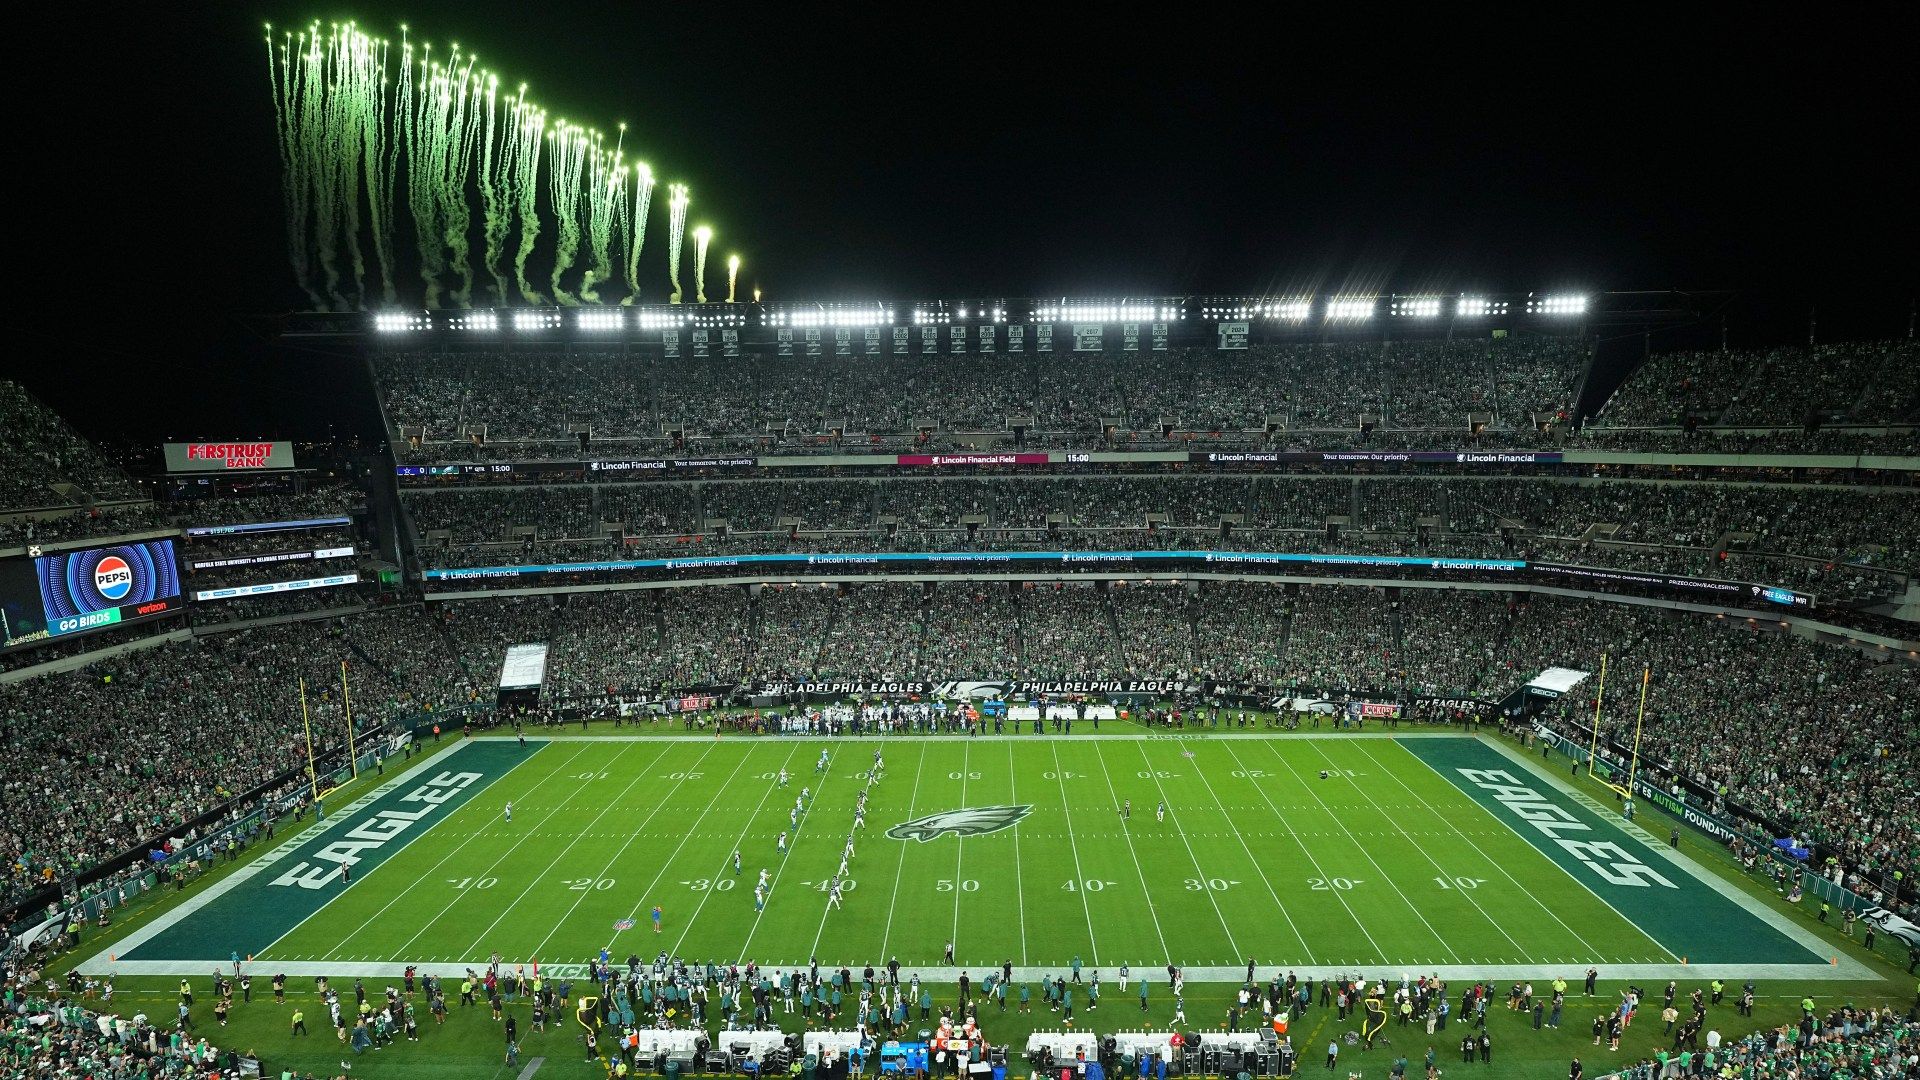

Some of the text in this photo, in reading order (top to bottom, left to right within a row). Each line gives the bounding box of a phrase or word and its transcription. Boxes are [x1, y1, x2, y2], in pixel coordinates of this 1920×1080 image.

[226, 457, 267, 468] BANK
[999, 455, 1016, 463] Field
[1067, 454, 1089, 462] 15:00
[1245, 453, 1278, 461] Financial
[1467, 453, 1535, 462] Lincoln Financial
[601, 461, 667, 470] Lincoln Financial
[29, 546, 41, 556] 25
[1099, 553, 1133, 561] Financial
[675, 558, 738, 568] Lincoln Financial
[1215, 554, 1279, 564] Lincoln Financial
[1442, 560, 1514, 571] Lincoln Financial
[450, 568, 520, 579] Lincoln Financial
[563, 565, 596, 573] tomorrow.
[98, 571, 130, 584] PEPSI
[1762, 590, 1807, 606] FREE EAGLES WIFI
[137, 602, 166, 615] verizon
[60, 612, 110, 631] GO BIRDS
[871, 682, 923, 693] EAGLES
[1022, 681, 1122, 692] PHILADELPHIA
[1531, 687, 1558, 698] GEICO
[1432, 698, 1475, 709] EAGLES
[1653, 793, 1682, 815] AUTISM
[1684, 810, 1737, 841] FOUNDATIO
[249, 783, 398, 868] IT TAKES ALL OF US
[267, 770, 484, 890] EAGLES
[1454, 768, 1681, 890] EAGLES
[1622, 825, 1672, 851] LOVE
[452, 876, 498, 890] 10
[568, 877, 616, 891] 20
[690, 878, 736, 892] 30
[812, 878, 857, 892] 40
[935, 879, 980, 892] 50
[1060, 879, 1104, 892] 40
[1183, 878, 1229, 892] 30
[1306, 877, 1354, 891] 20
[1432, 876, 1478, 890] 10
